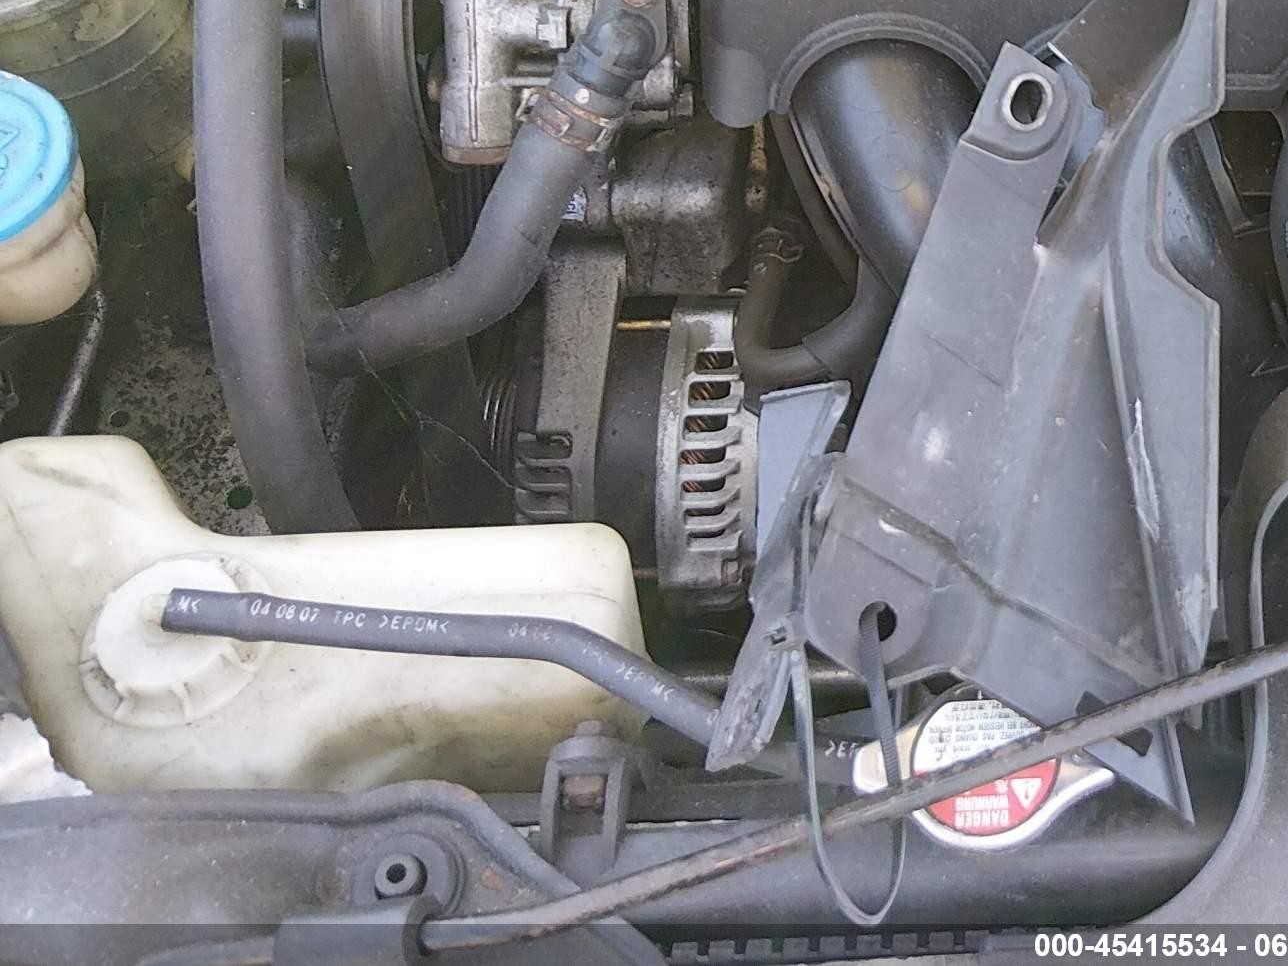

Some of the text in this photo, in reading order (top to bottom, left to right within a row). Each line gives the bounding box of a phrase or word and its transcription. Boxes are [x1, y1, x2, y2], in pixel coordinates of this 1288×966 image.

[250, 599, 270, 618] 04
[275, 604, 295, 620] 08
[299, 606, 320, 623] 07
[954, 810, 1009, 829] DANGER
